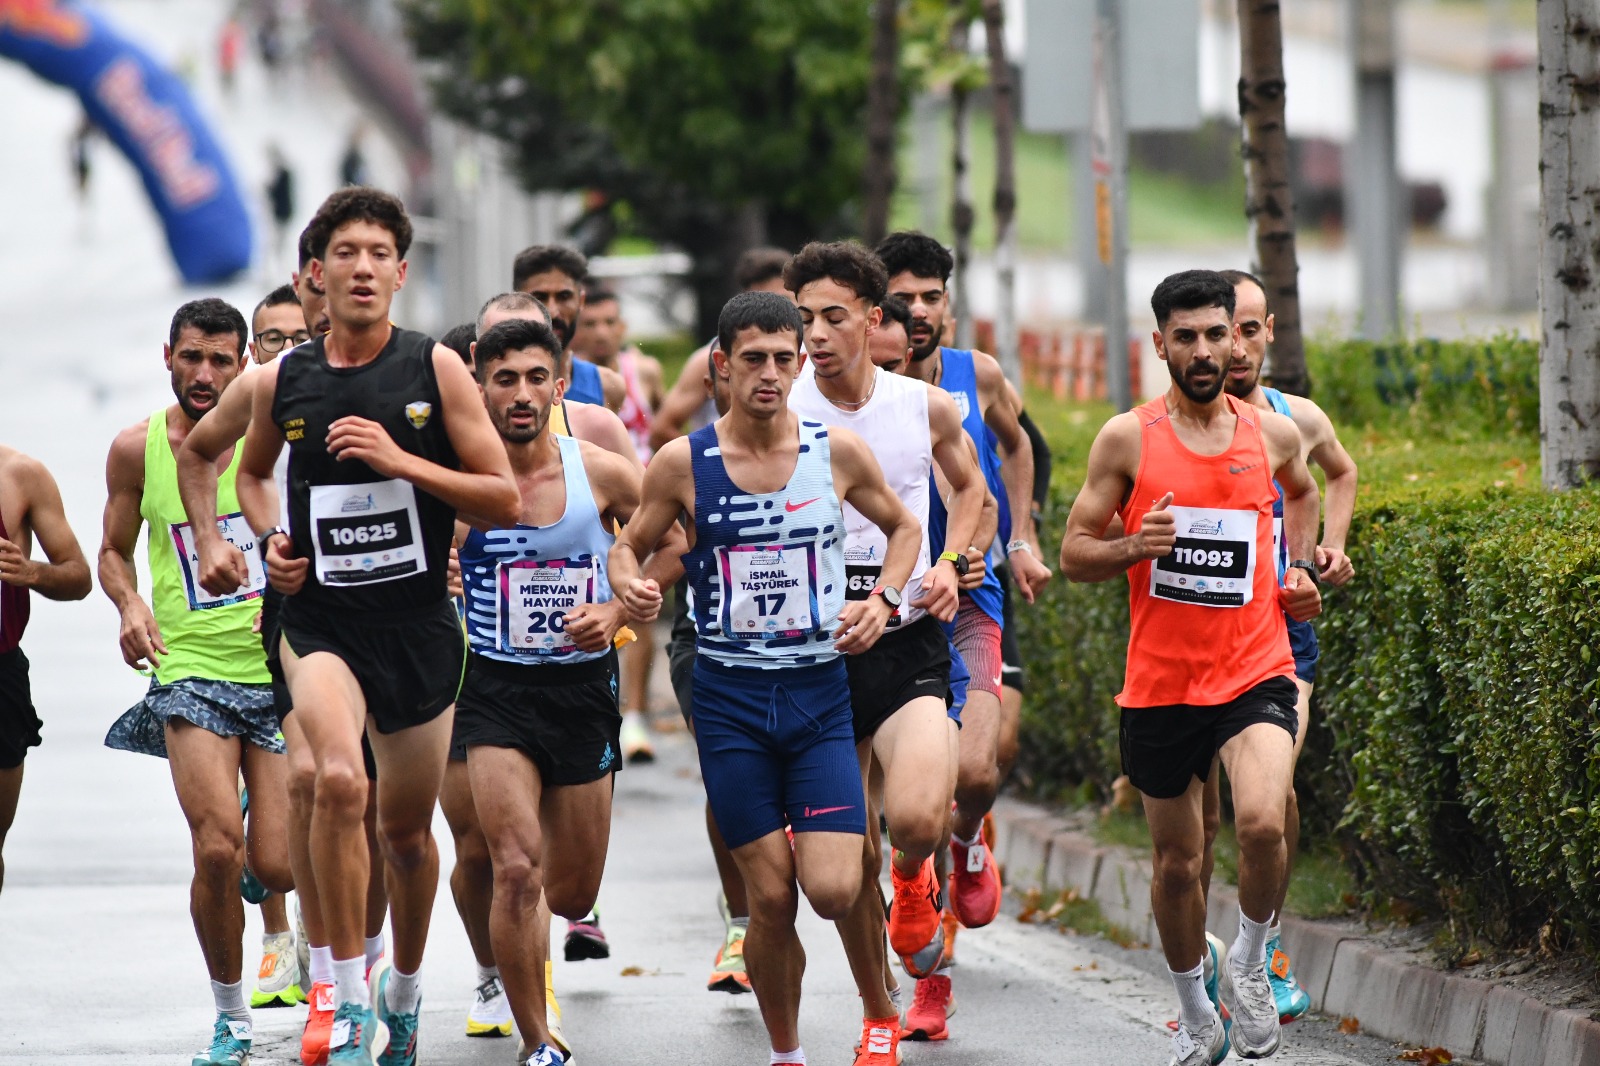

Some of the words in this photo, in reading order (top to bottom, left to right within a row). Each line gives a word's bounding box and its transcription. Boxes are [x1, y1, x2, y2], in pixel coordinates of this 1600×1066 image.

[329, 521, 398, 547] 10625
[1174, 547, 1235, 568] 11093
[520, 585, 578, 595] MERVAN
[741, 578, 800, 592] TAŞYÜREK
[845, 575, 880, 591] 63
[523, 598, 575, 608] HAYKIR
[753, 593, 787, 616] 17
[528, 611, 570, 634] 20
